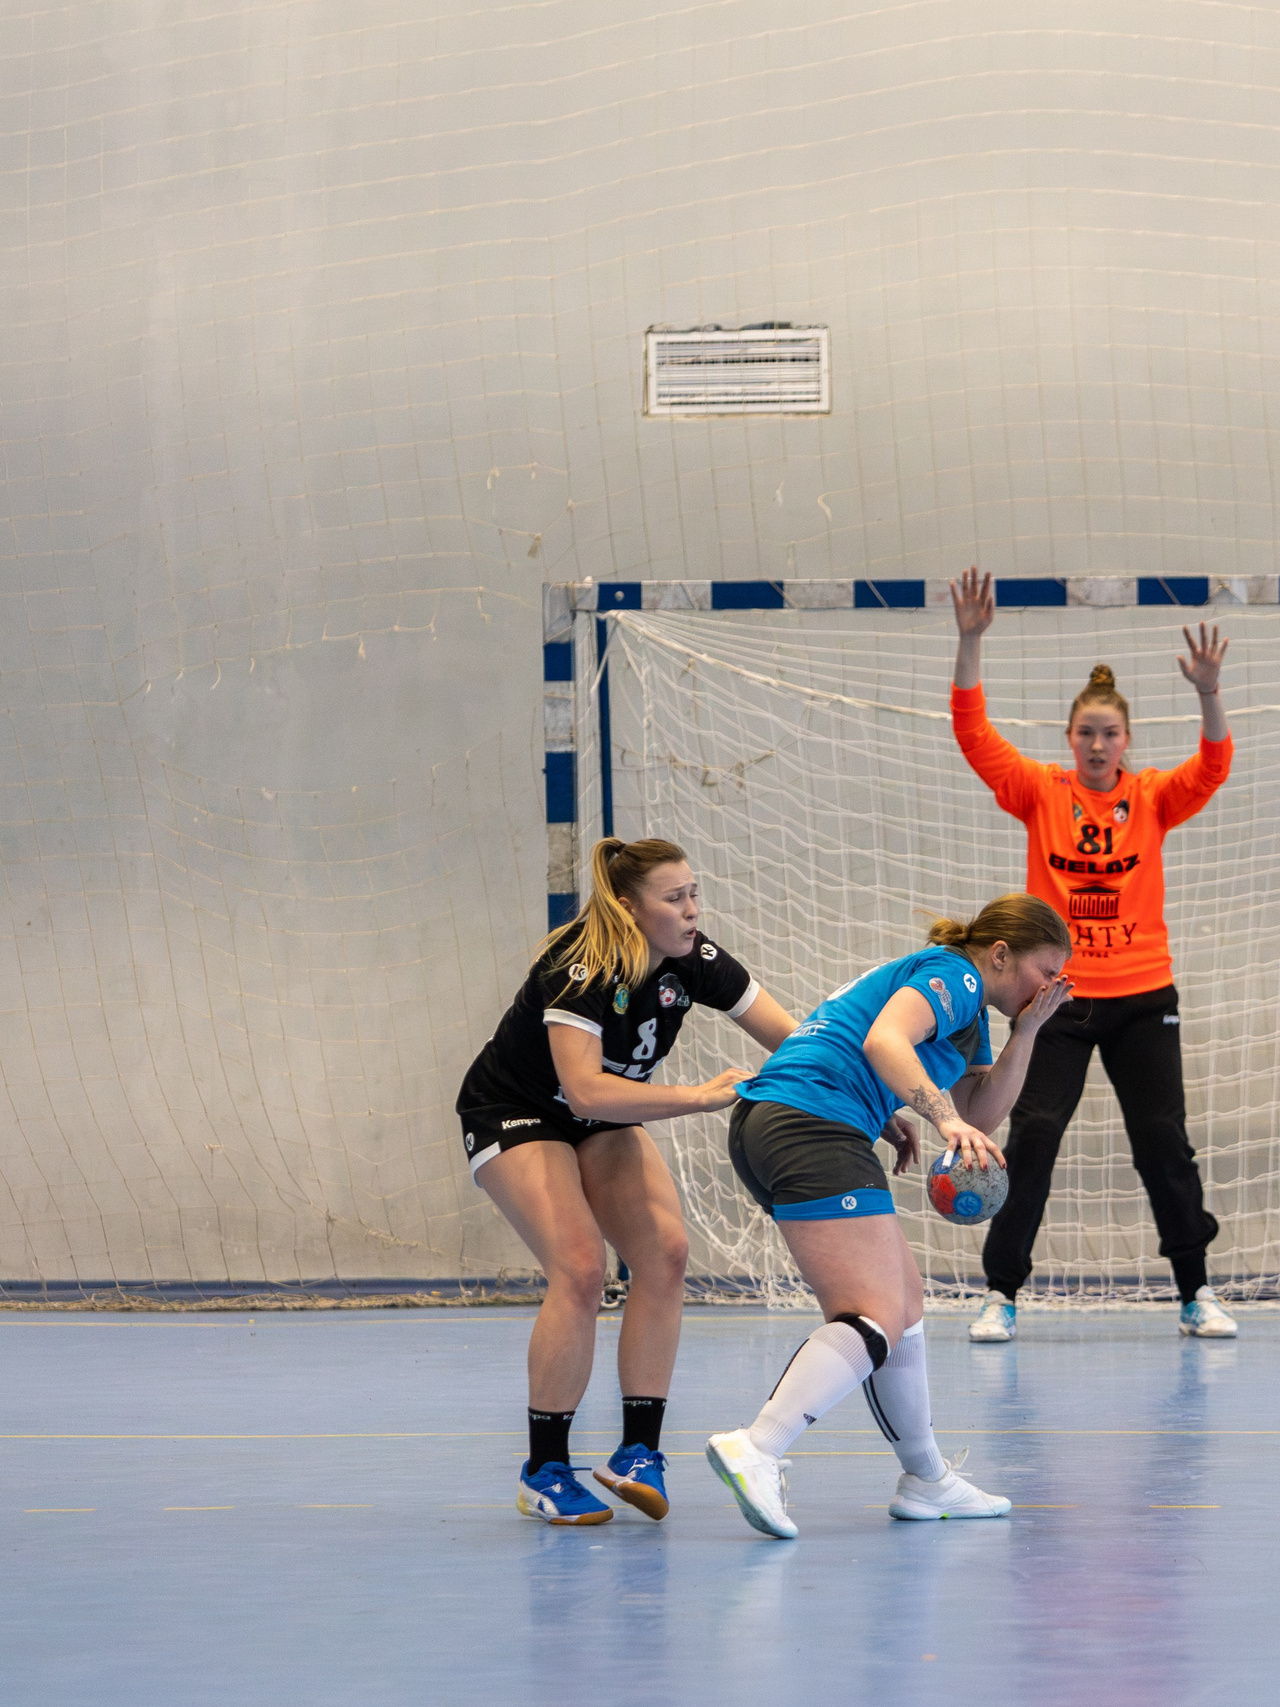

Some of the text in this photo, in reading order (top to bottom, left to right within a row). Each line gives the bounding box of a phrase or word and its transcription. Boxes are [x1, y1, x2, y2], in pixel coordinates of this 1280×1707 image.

[1077, 824, 1113, 855] 81
[1049, 852, 1141, 874] BELAZ
[1067, 922, 1137, 947] НТУ
[632, 1017, 657, 1060] 8
[501, 1118, 541, 1130] Kempa
